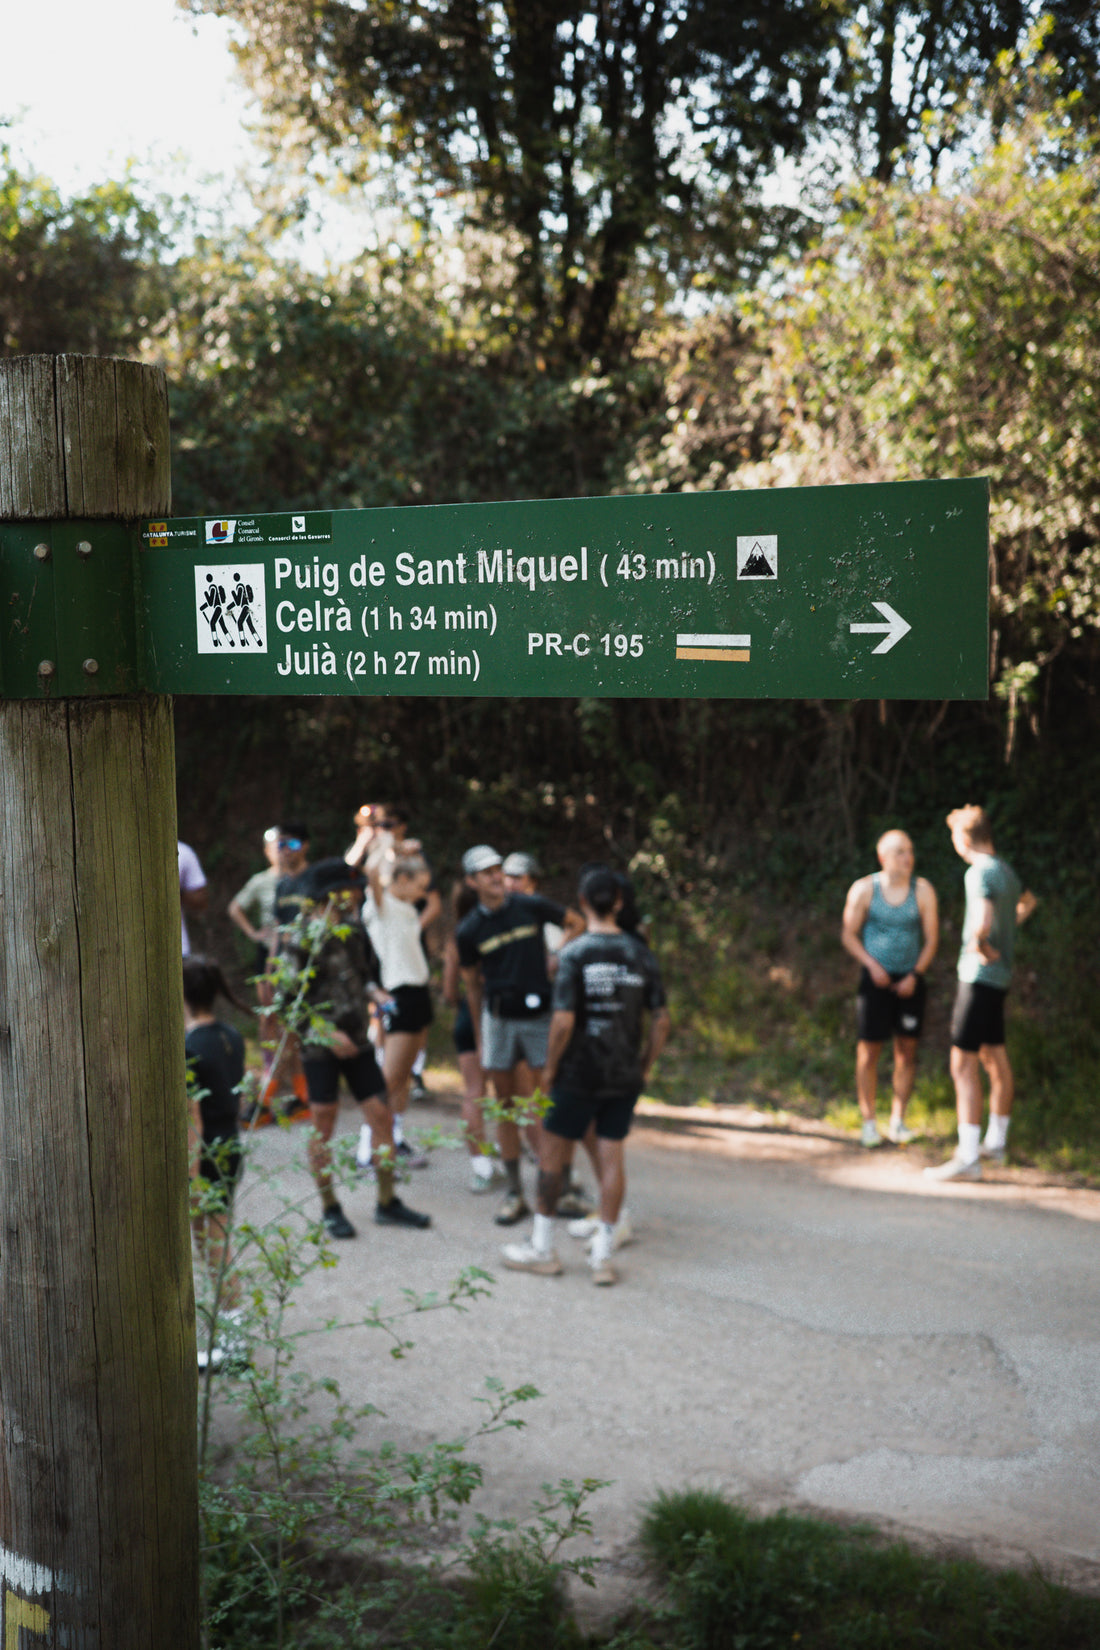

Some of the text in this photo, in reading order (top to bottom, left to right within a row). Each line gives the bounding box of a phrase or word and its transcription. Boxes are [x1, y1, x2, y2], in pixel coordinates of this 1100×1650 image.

[274, 556, 340, 597] Puig
[349, 554, 386, 587] de
[395, 552, 467, 586] Sant
[477, 546, 588, 591] Miquel
[655, 550, 717, 585] min)
[275, 598, 498, 637] Celrà (1 h 34 min)
[276, 642, 481, 682] Juià (2 h 27 min)
[527, 632, 643, 658] PR-C 195
